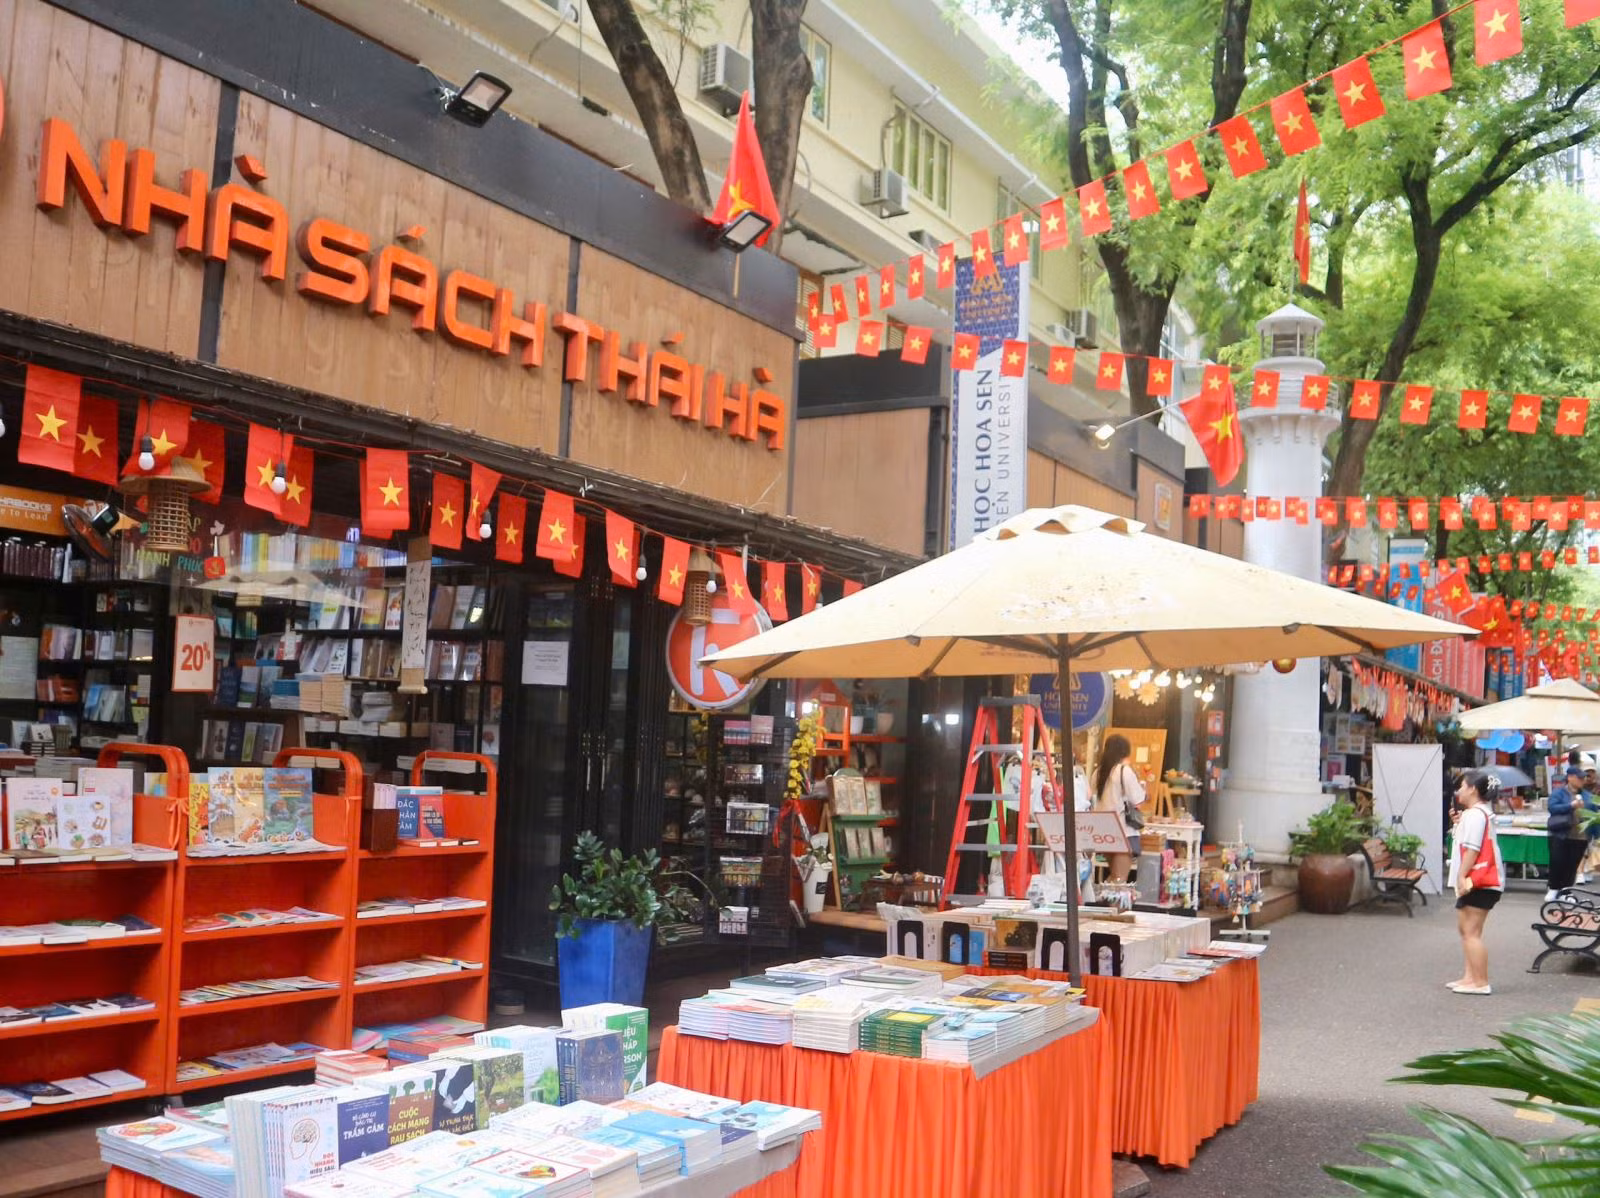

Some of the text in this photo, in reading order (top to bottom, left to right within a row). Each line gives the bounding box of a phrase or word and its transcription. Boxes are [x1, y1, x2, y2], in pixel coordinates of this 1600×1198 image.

[37, 117, 784, 451] NHÀ SÁCH THÁI HÀ
[997, 371, 1011, 480] UNIVERSI
[974, 369, 996, 534] HỌC HOA SEN
[623, 1040, 638, 1051] HÁP
[398, 1106, 419, 1119] CUỘC
[387, 1120, 407, 1134] CÁCH
[407, 1116, 430, 1129] MẠNG
[390, 1133, 406, 1145] RAU
